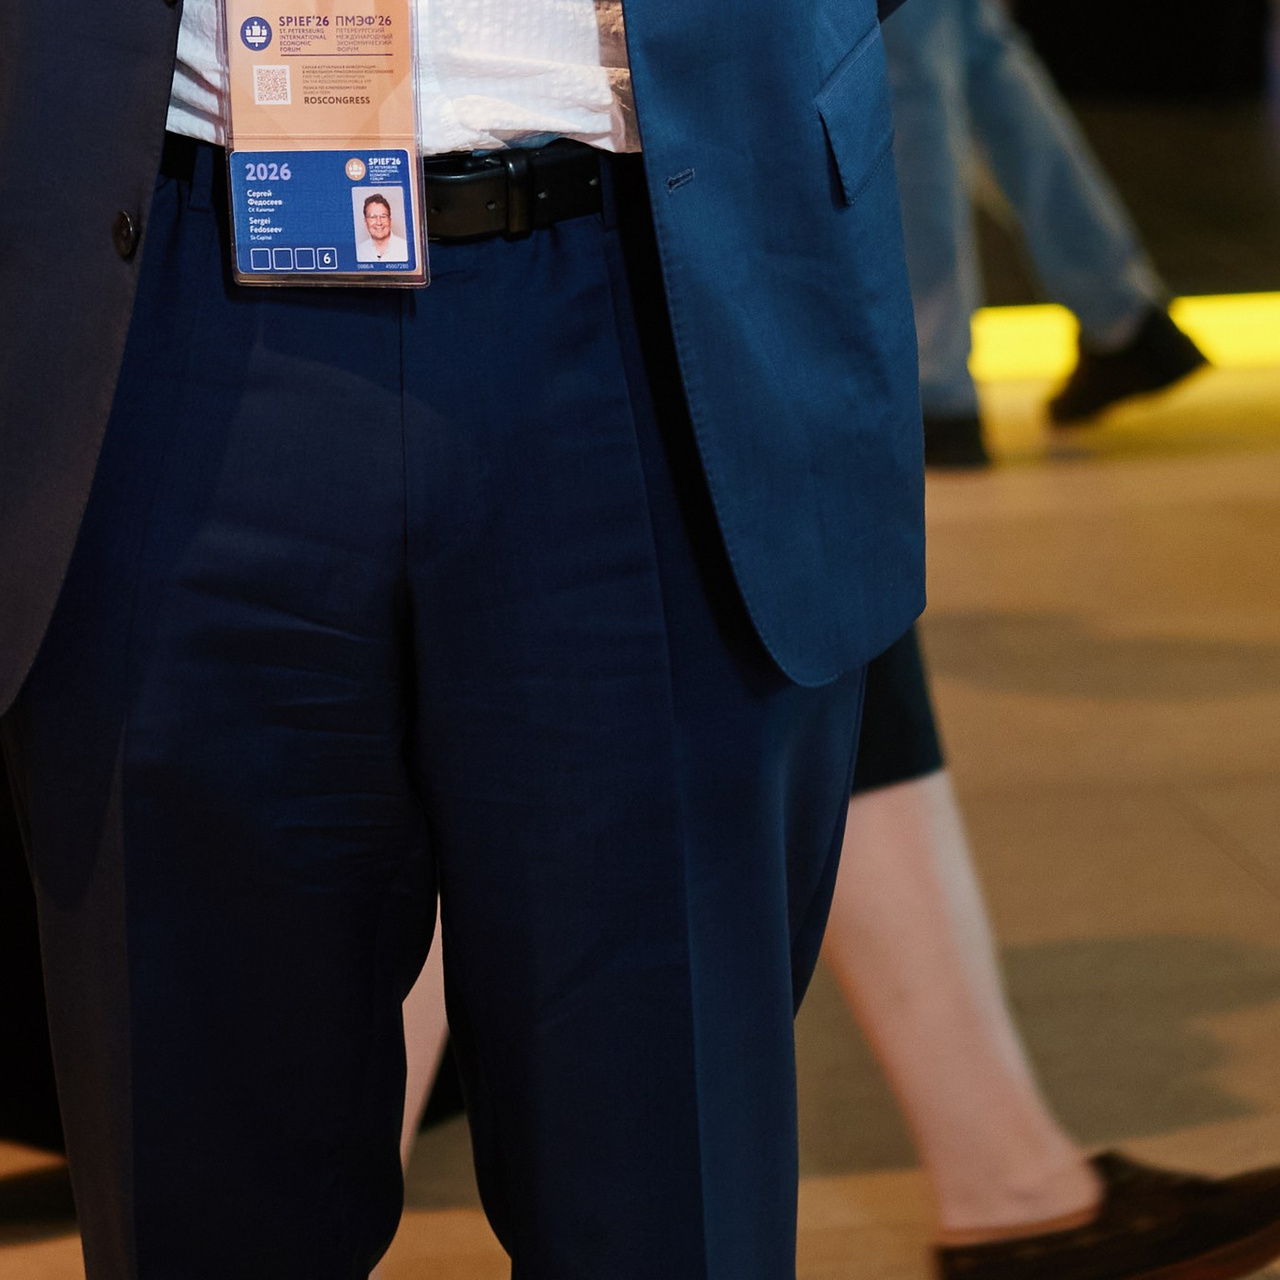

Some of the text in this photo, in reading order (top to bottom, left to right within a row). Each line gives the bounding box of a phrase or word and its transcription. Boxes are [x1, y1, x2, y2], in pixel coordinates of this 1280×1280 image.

[304, 96, 370, 104] ROSCONGRESS
[245, 163, 292, 181] 2026
[247, 189, 272, 199] Сергей
[248, 198, 282, 206] Федосеев
[249, 217, 271, 226] Sergei
[250, 225, 282, 233] Fedoseev
[323, 253, 331, 264] 6
